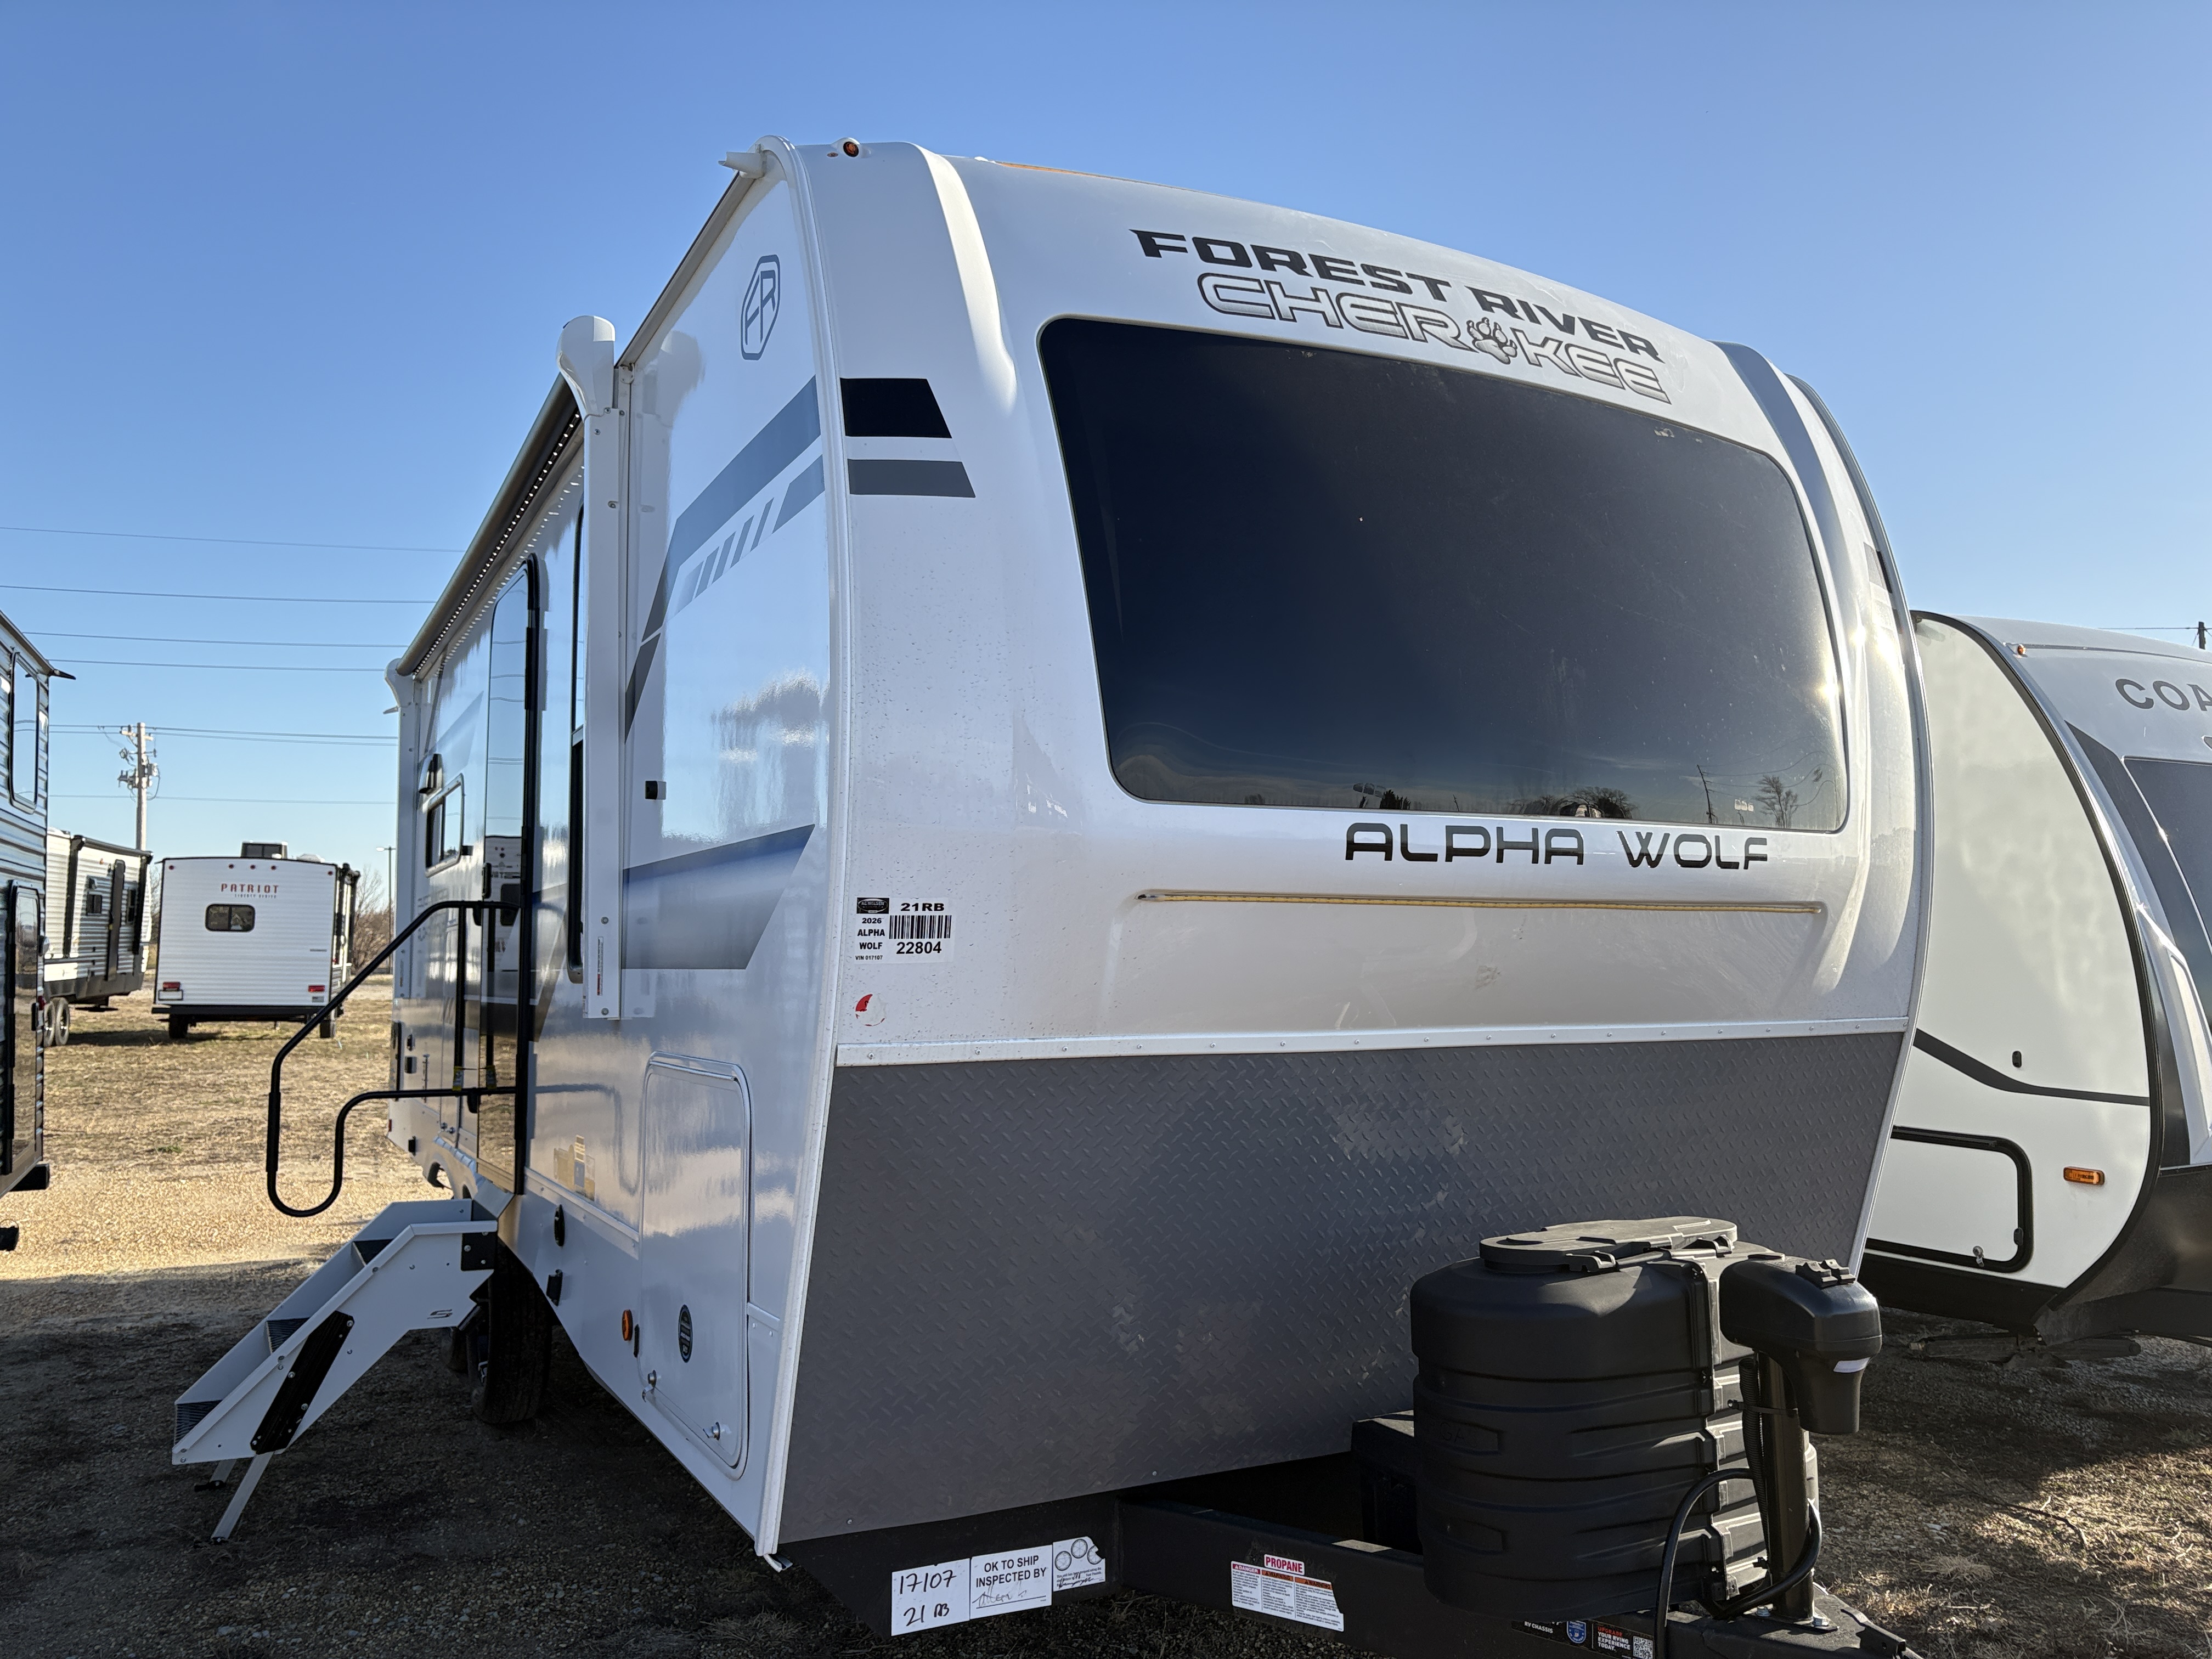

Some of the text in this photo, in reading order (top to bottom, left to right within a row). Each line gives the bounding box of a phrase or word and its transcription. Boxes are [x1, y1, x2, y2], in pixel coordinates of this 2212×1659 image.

[1129, 229, 1665, 364] FOREST RIVER
[1345, 822, 1768, 870] ALPHA WOLF
[221, 883, 279, 894] PATRIOT
[900, 902, 945, 912] 21RB
[896, 941, 942, 954] 22804
[984, 1555, 1039, 1573] OK TO SHIP
[1239, 1565, 1259, 1573] DANGER
[1266, 1556, 1303, 1573] PROPANE
[899, 1570, 957, 1595] 17107
[975, 1567, 1047, 1588] INSPECTED BY
[904, 1605, 926, 1627] 21
[1532, 1623, 1554, 1634] CHASSIS
[1598, 1627, 1623, 1637] UPGRADE
[1598, 1637, 1631, 1650] EXPERIENCE
[1612, 1635, 1629, 1644] RVING
[1598, 1642, 1616, 1651] TODAY.
